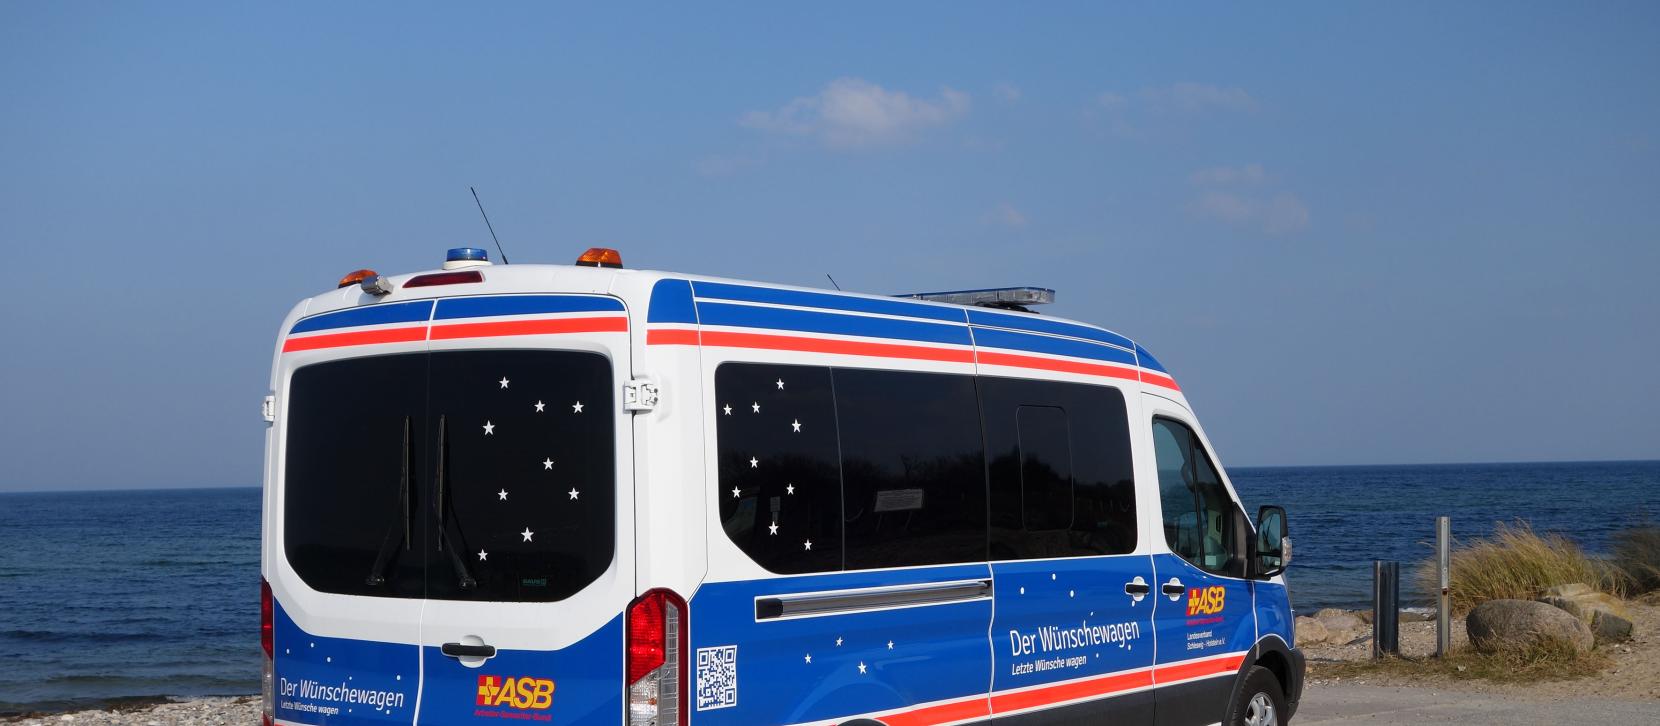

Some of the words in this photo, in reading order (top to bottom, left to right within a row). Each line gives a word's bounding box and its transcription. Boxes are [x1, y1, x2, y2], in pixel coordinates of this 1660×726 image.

[1195, 586, 1225, 614] ASB
[1009, 630, 1036, 656] Der
[1038, 620, 1140, 652] Wünschewagen
[1011, 663, 1034, 676] Letzte
[1035, 656, 1065, 672] Wünsche
[1066, 655, 1087, 669] wagen
[280, 677, 298, 697] Der
[300, 679, 404, 710] Wünschewagen
[280, 700, 294, 710] Letzte
[294, 701, 317, 713] Wünsche
[318, 704, 339, 716] wagen
[494, 677, 555, 709] ASB
